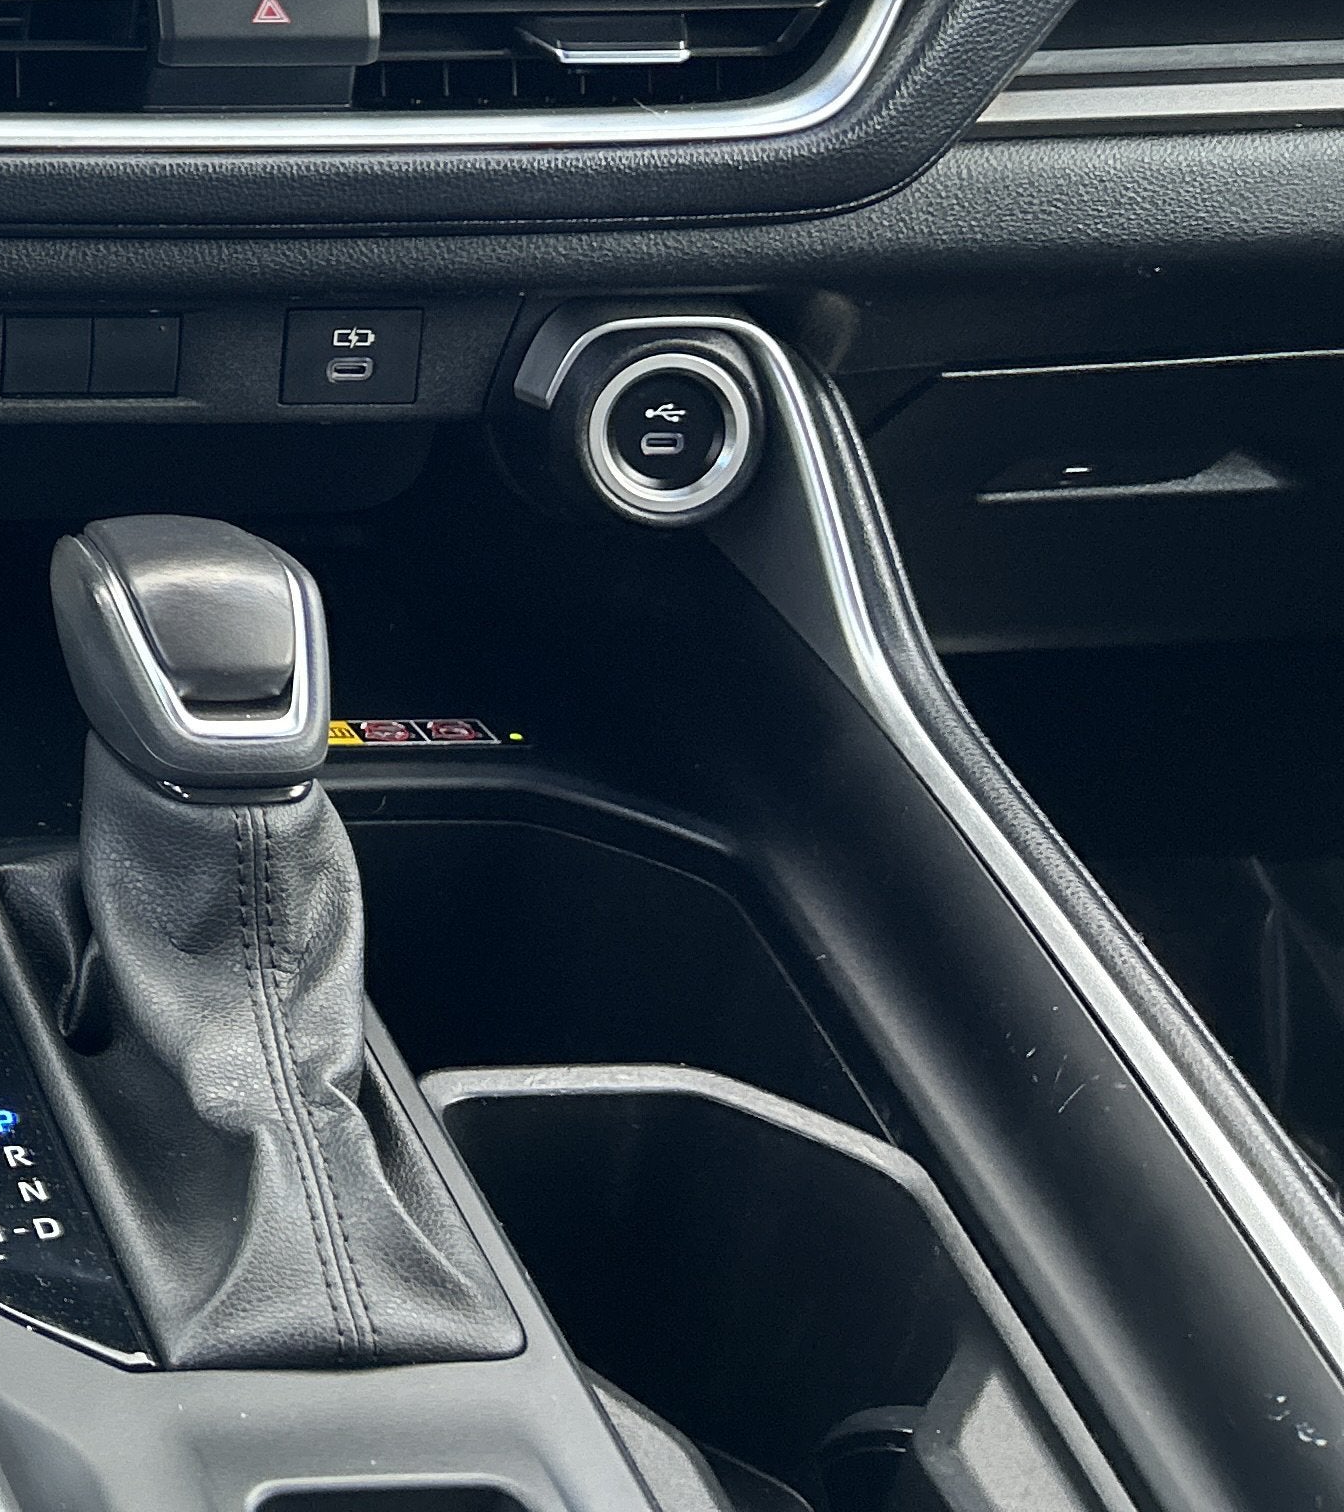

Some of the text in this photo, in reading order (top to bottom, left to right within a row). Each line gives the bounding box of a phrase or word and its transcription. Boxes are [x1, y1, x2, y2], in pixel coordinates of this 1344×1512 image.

[2, 1145, 33, 1168] R
[17, 1180, 50, 1204] N
[32, 1217, 64, 1242] D
